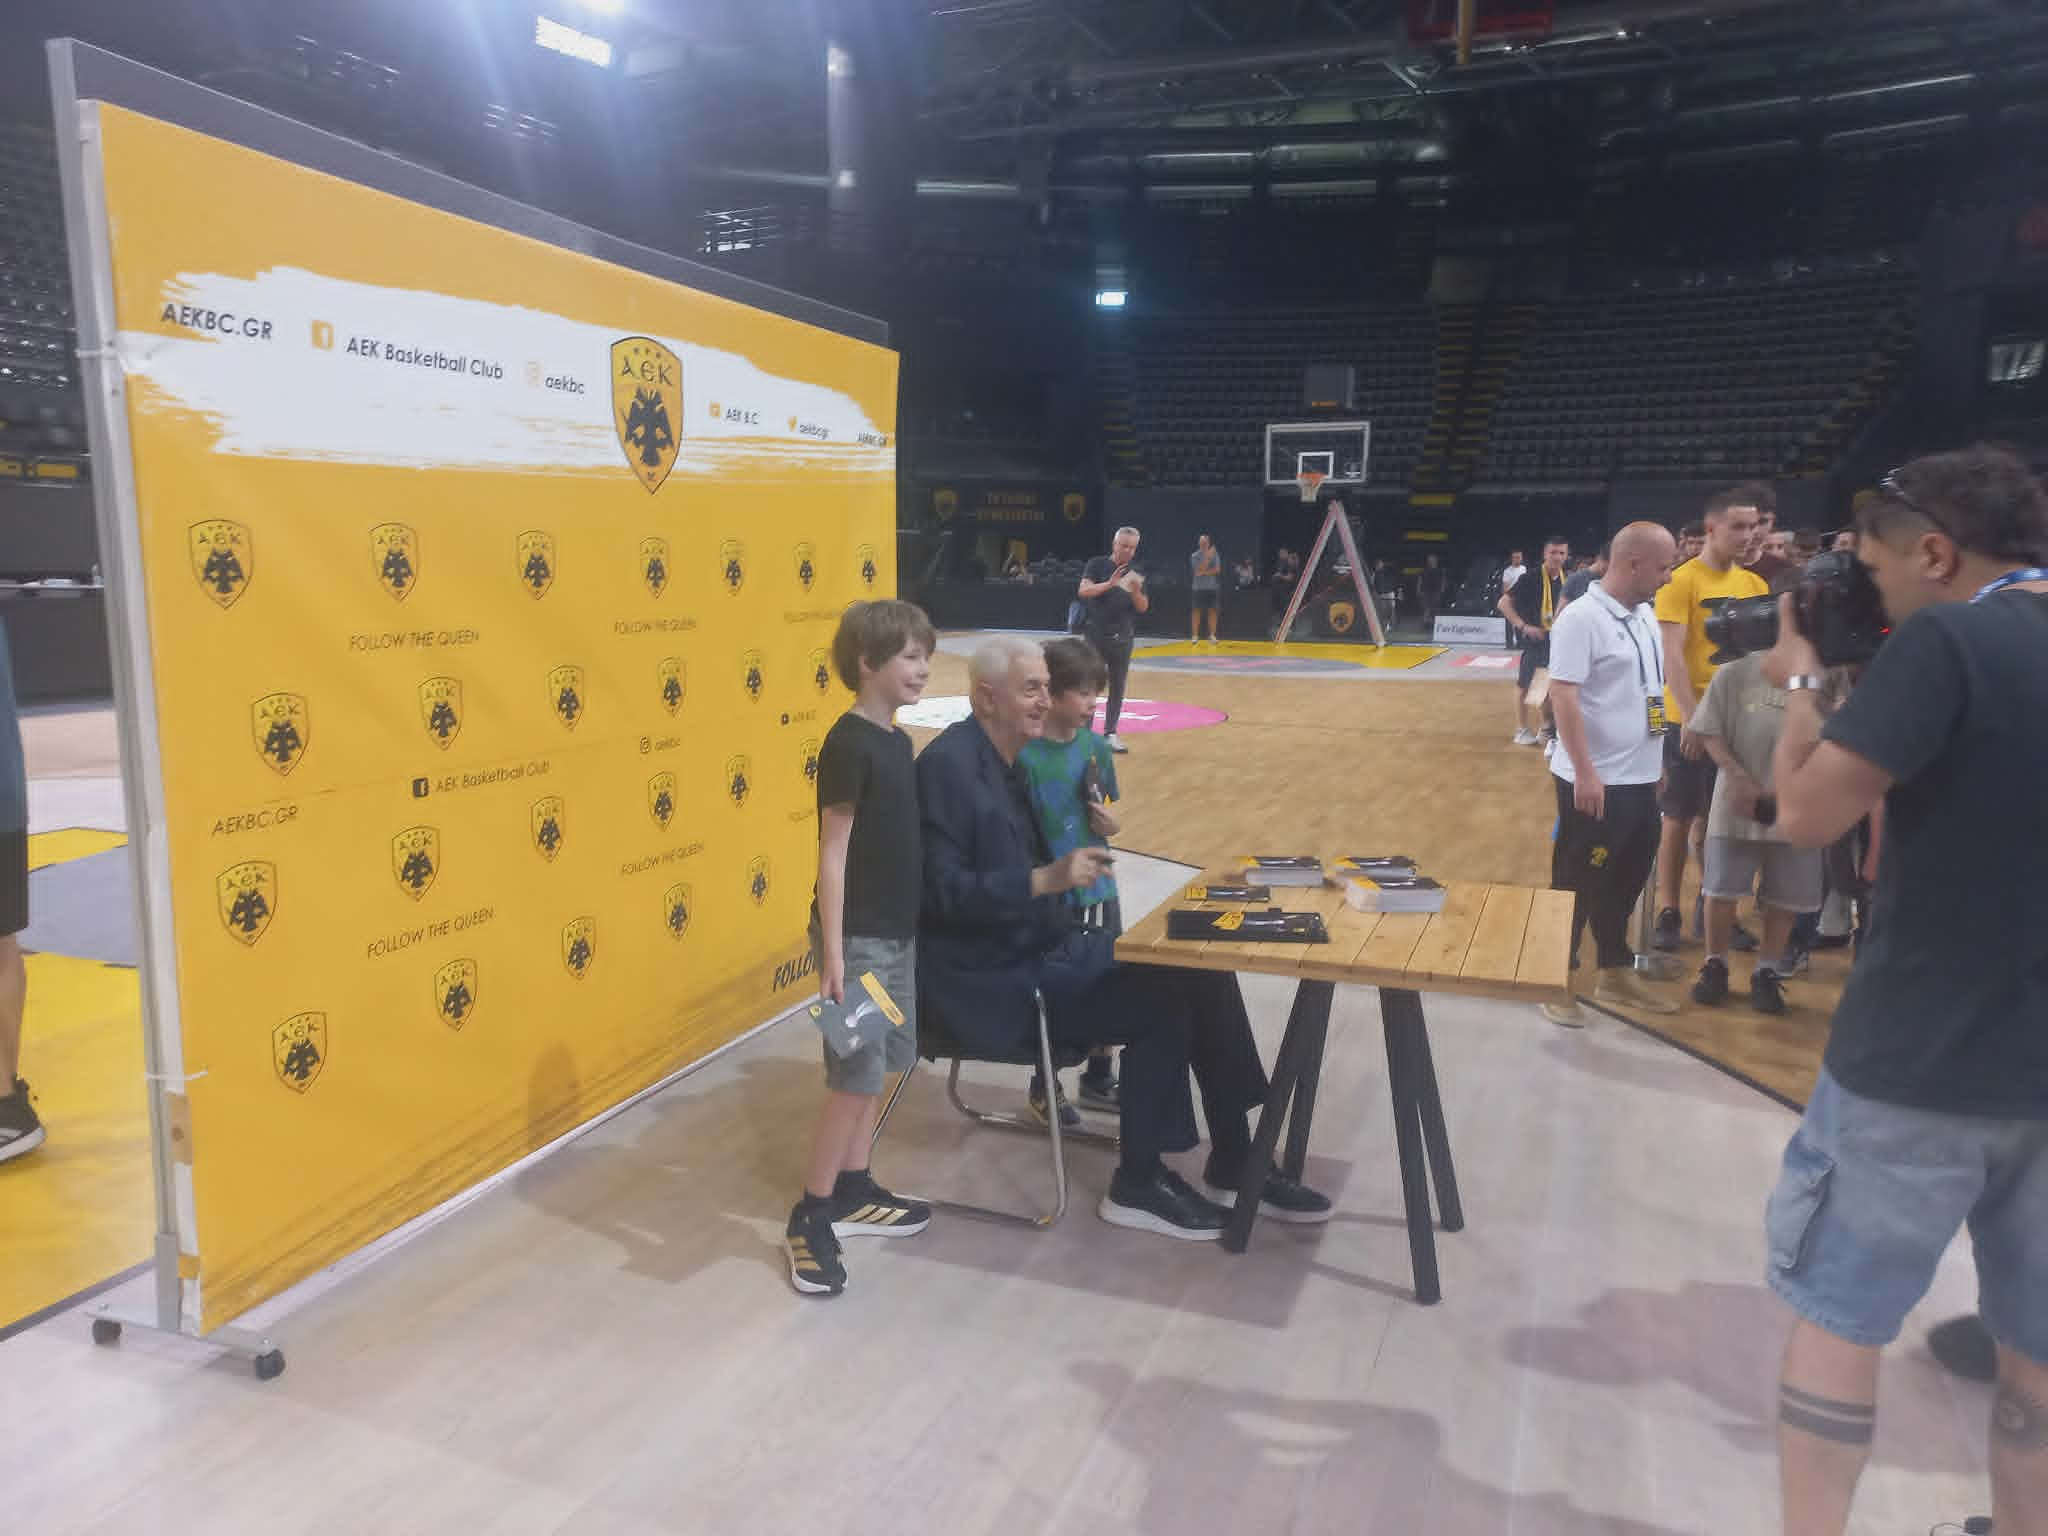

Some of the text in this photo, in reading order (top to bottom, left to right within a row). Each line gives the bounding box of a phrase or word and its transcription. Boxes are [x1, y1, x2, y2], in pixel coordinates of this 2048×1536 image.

[161, 303, 273, 340] AEKBC.GR
[346, 337, 503, 379] AEK Basketball Club
[545, 374, 585, 395] aekbc
[350, 629, 479, 650] FOLLOW THE QUEEN
[211, 806, 298, 837] AEKBC.GR
[367, 906, 493, 960] FOLLOW THE QUEEN
